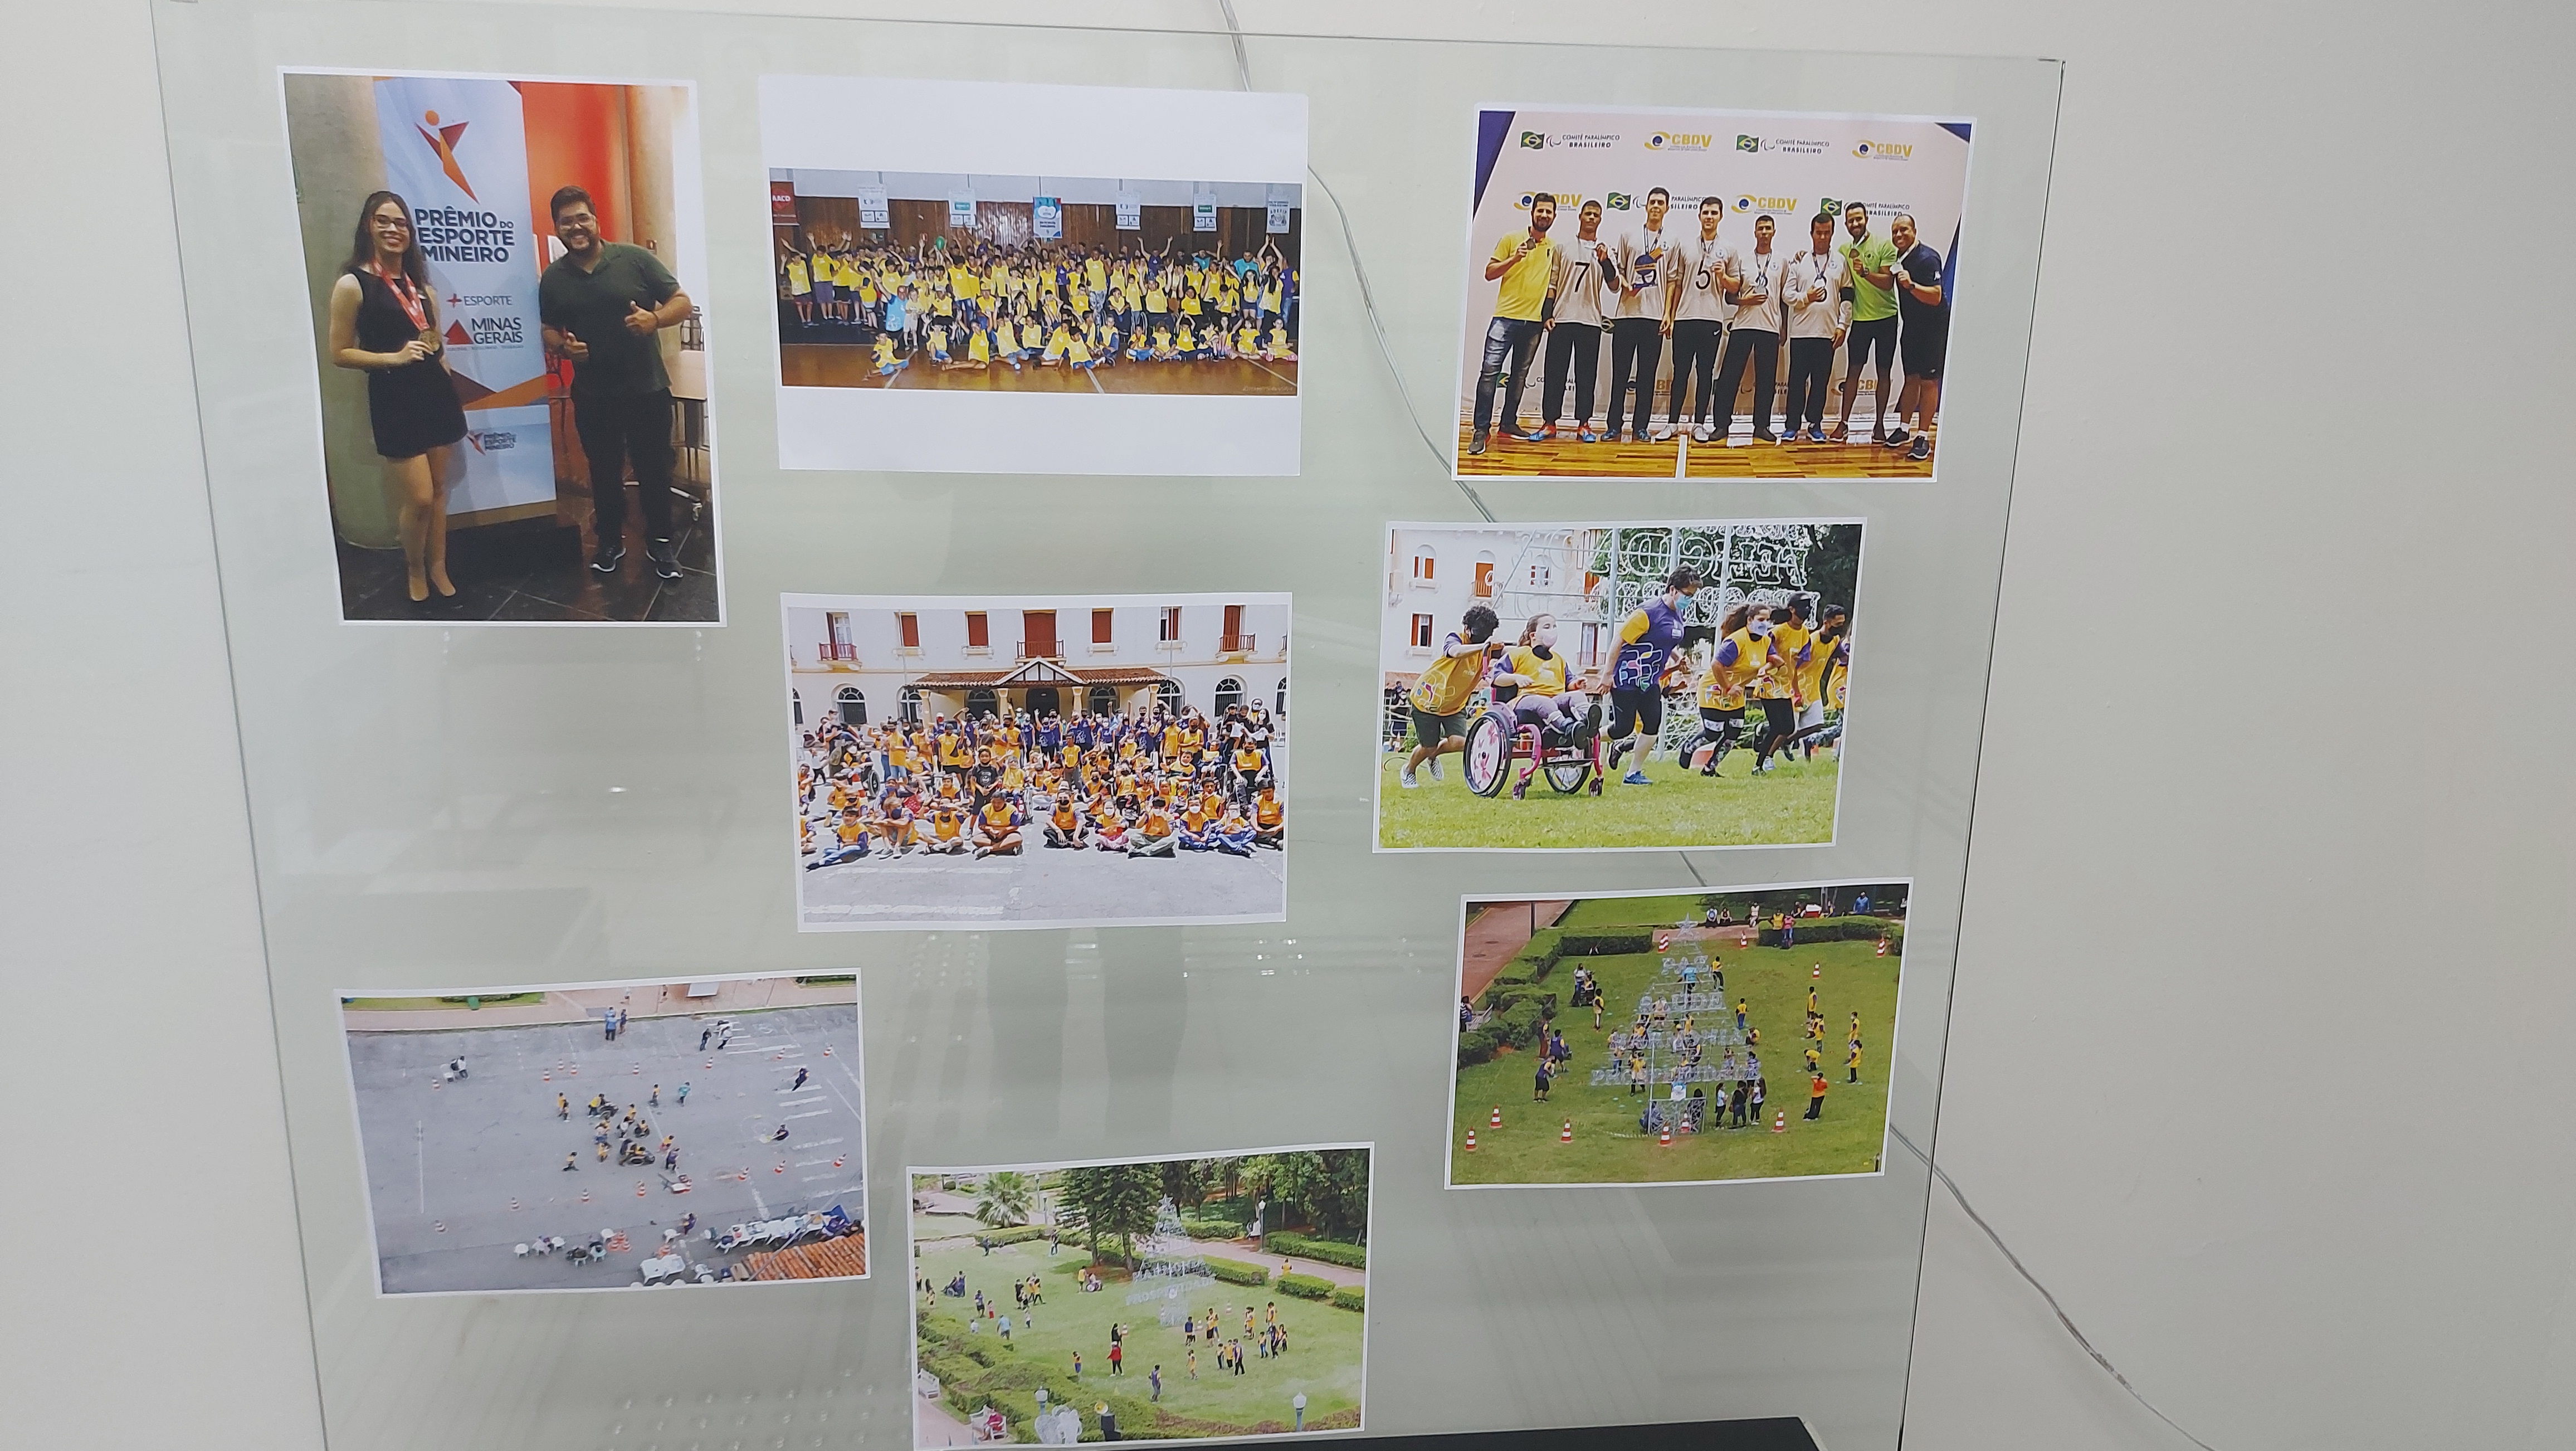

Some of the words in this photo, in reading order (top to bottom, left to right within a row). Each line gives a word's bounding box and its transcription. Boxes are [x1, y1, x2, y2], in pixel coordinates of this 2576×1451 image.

[1672, 134, 1712, 148] CBDV
[1877, 143, 1913, 157] CBDV
[1758, 197, 1798, 211] CBDV
[415, 206, 496, 229] PRÊMIO
[500, 220, 514, 229] DO
[418, 228, 515, 246] ESPORTE
[421, 245, 509, 263] MINEIRO
[1574, 261, 1589, 293] 7
[1696, 257, 1711, 290] 5
[464, 295, 512, 306] ESPORTE
[471, 317, 522, 332] MINAS
[474, 330, 524, 345] GERAIS
